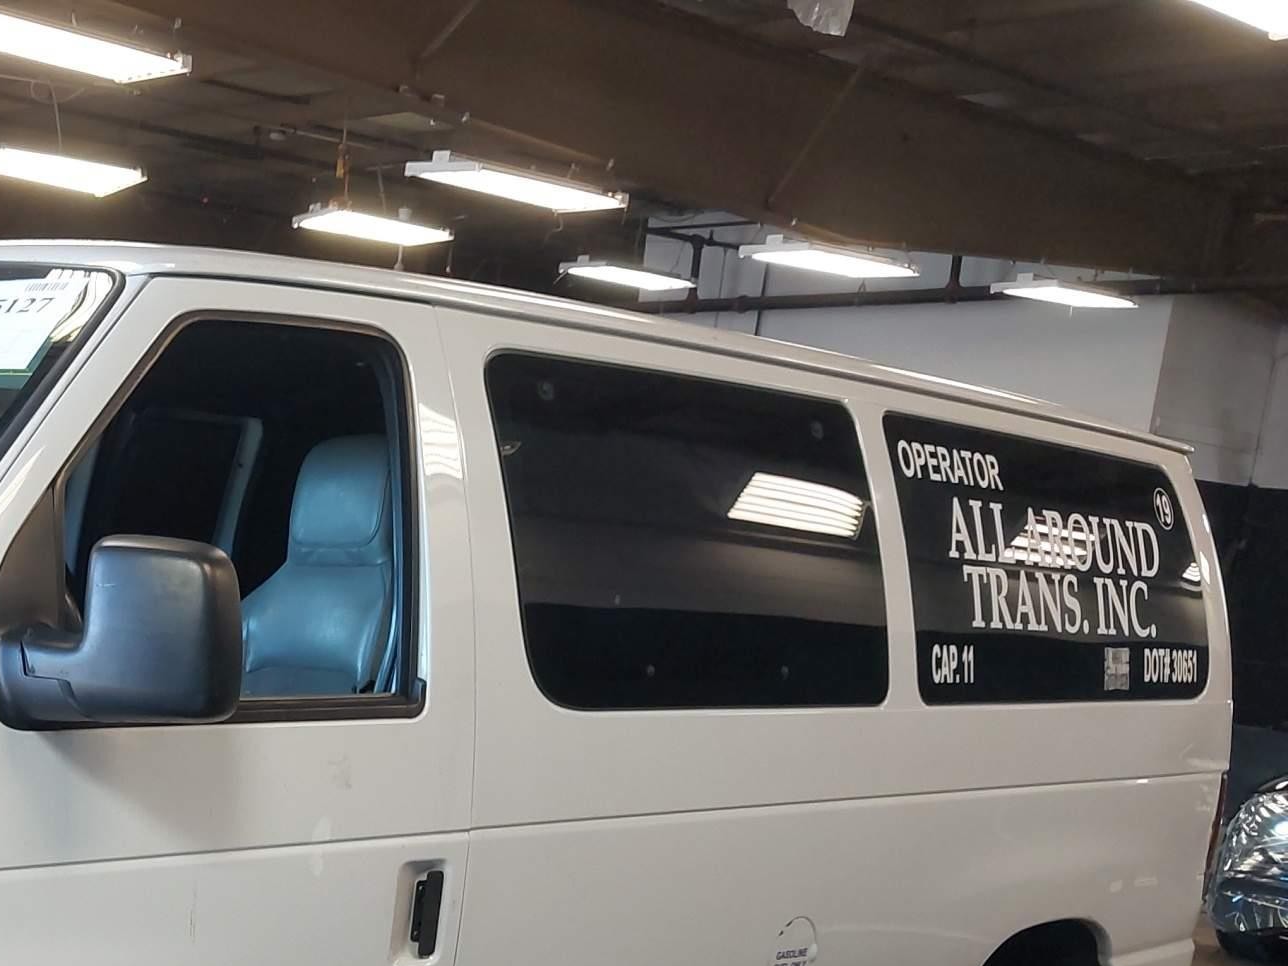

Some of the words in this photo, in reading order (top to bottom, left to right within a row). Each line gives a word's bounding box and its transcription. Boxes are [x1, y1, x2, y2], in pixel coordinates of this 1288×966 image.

[897, 440, 1004, 491] OPERATOR
[1155, 493, 1172, 524] 19
[949, 496, 1016, 564] ALL
[1024, 506, 1160, 578] AROUND
[963, 565, 1090, 635] TRANS.
[1093, 576, 1158, 639] INC.
[932, 644, 960, 684] CAP.
[962, 645, 974, 684] 11
[1144, 648, 1171, 684] DOT#
[1172, 649, 1198, 684] 30651
